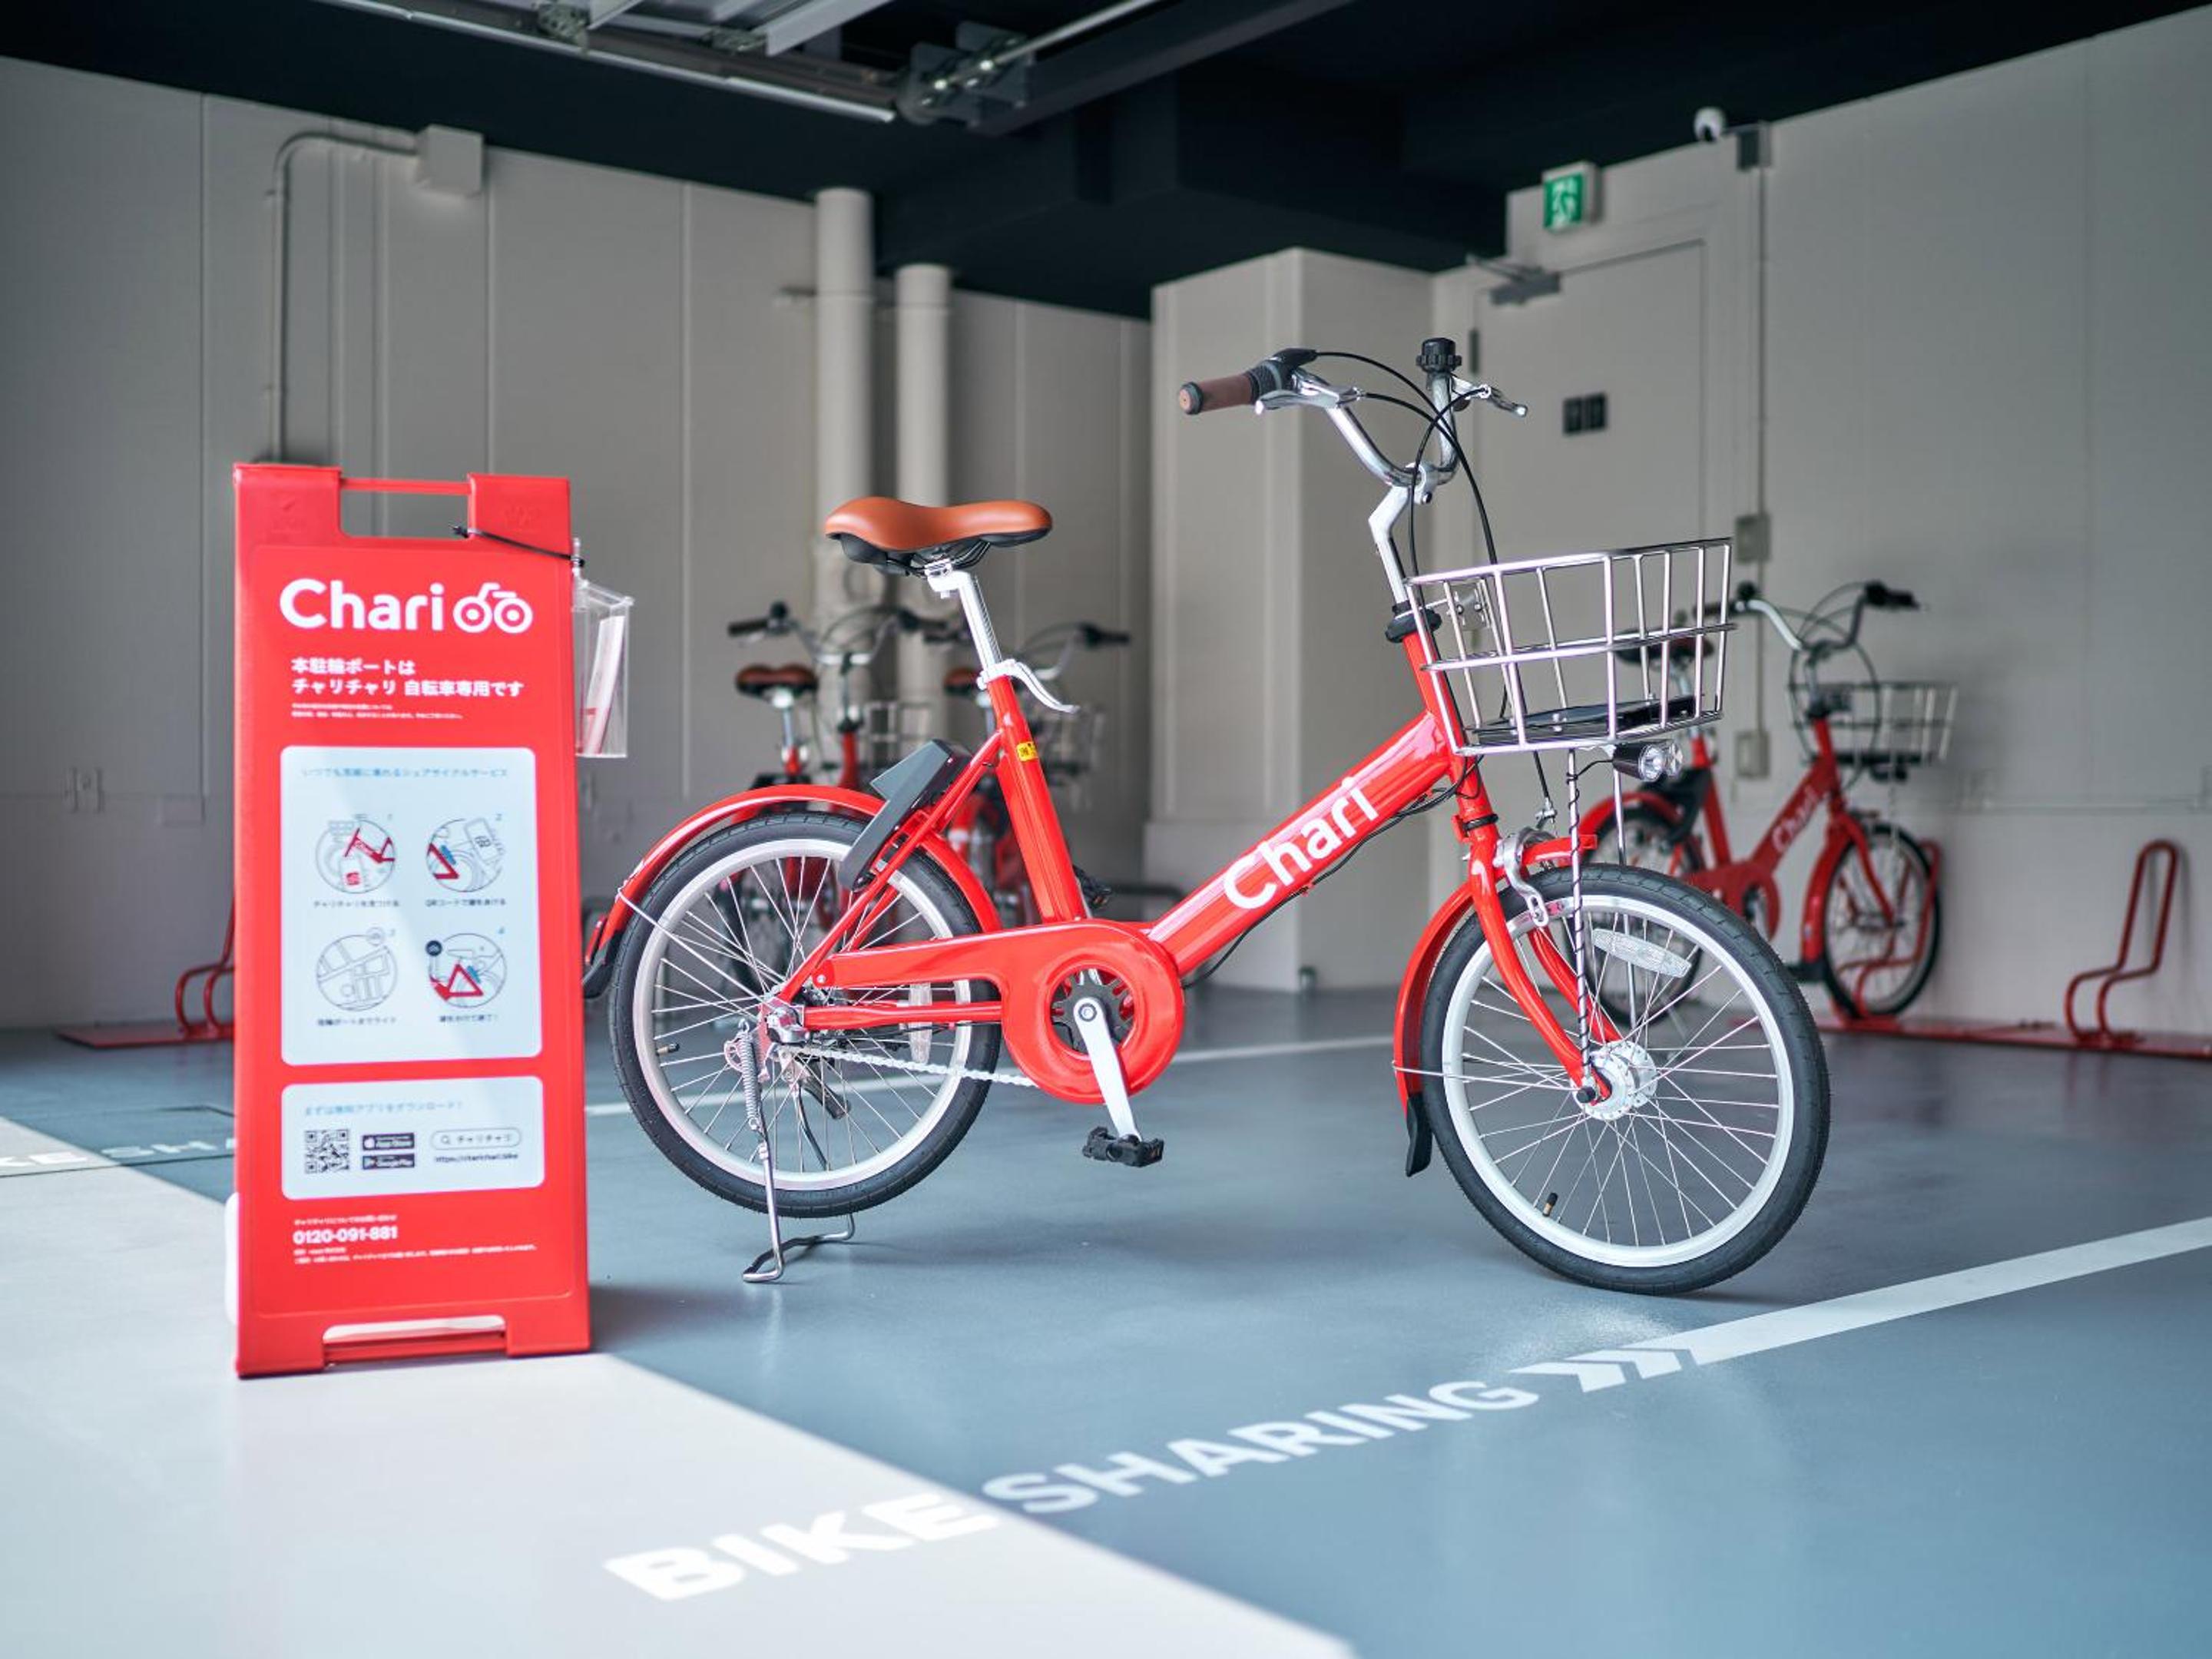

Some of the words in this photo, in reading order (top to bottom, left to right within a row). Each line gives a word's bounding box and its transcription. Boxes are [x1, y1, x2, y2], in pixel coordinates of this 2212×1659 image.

[280, 578, 444, 630] Chari
[291, 657, 416, 675] 本駐輪ポートは
[292, 678, 396, 695] チャリチャリ
[404, 680, 525, 697] 自転車専用です
[1224, 777, 1379, 909] Chari
[293, 1226, 398, 1244] 0120-091-881
[603, 1492, 999, 1601] BIKE
[982, 1380, 1539, 1513] SHARING
